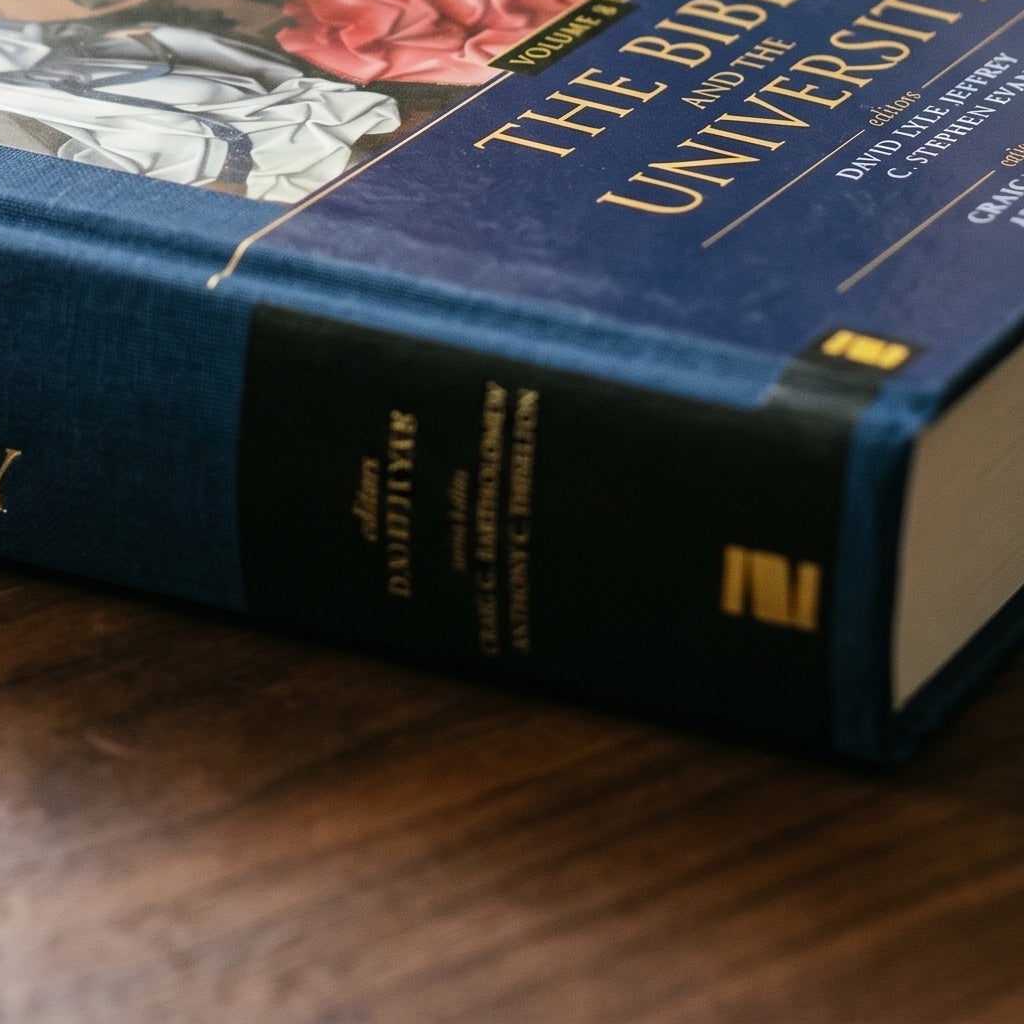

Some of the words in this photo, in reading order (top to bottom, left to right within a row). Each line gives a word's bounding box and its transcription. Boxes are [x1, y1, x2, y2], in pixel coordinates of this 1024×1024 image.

[509, 14, 601, 65] VOLUME
[681, 71, 745, 110] AND
[729, 36, 797, 70] THE
[474, 68, 668, 158] THE
[835, 139, 902, 181] DAVID
[892, 105, 950, 138] LYLE
[939, 52, 1018, 106] JEFFREY
[869, 90, 921, 127] editors
[887, 167, 917, 179] C.
[906, 105, 996, 164] STEPHEN
